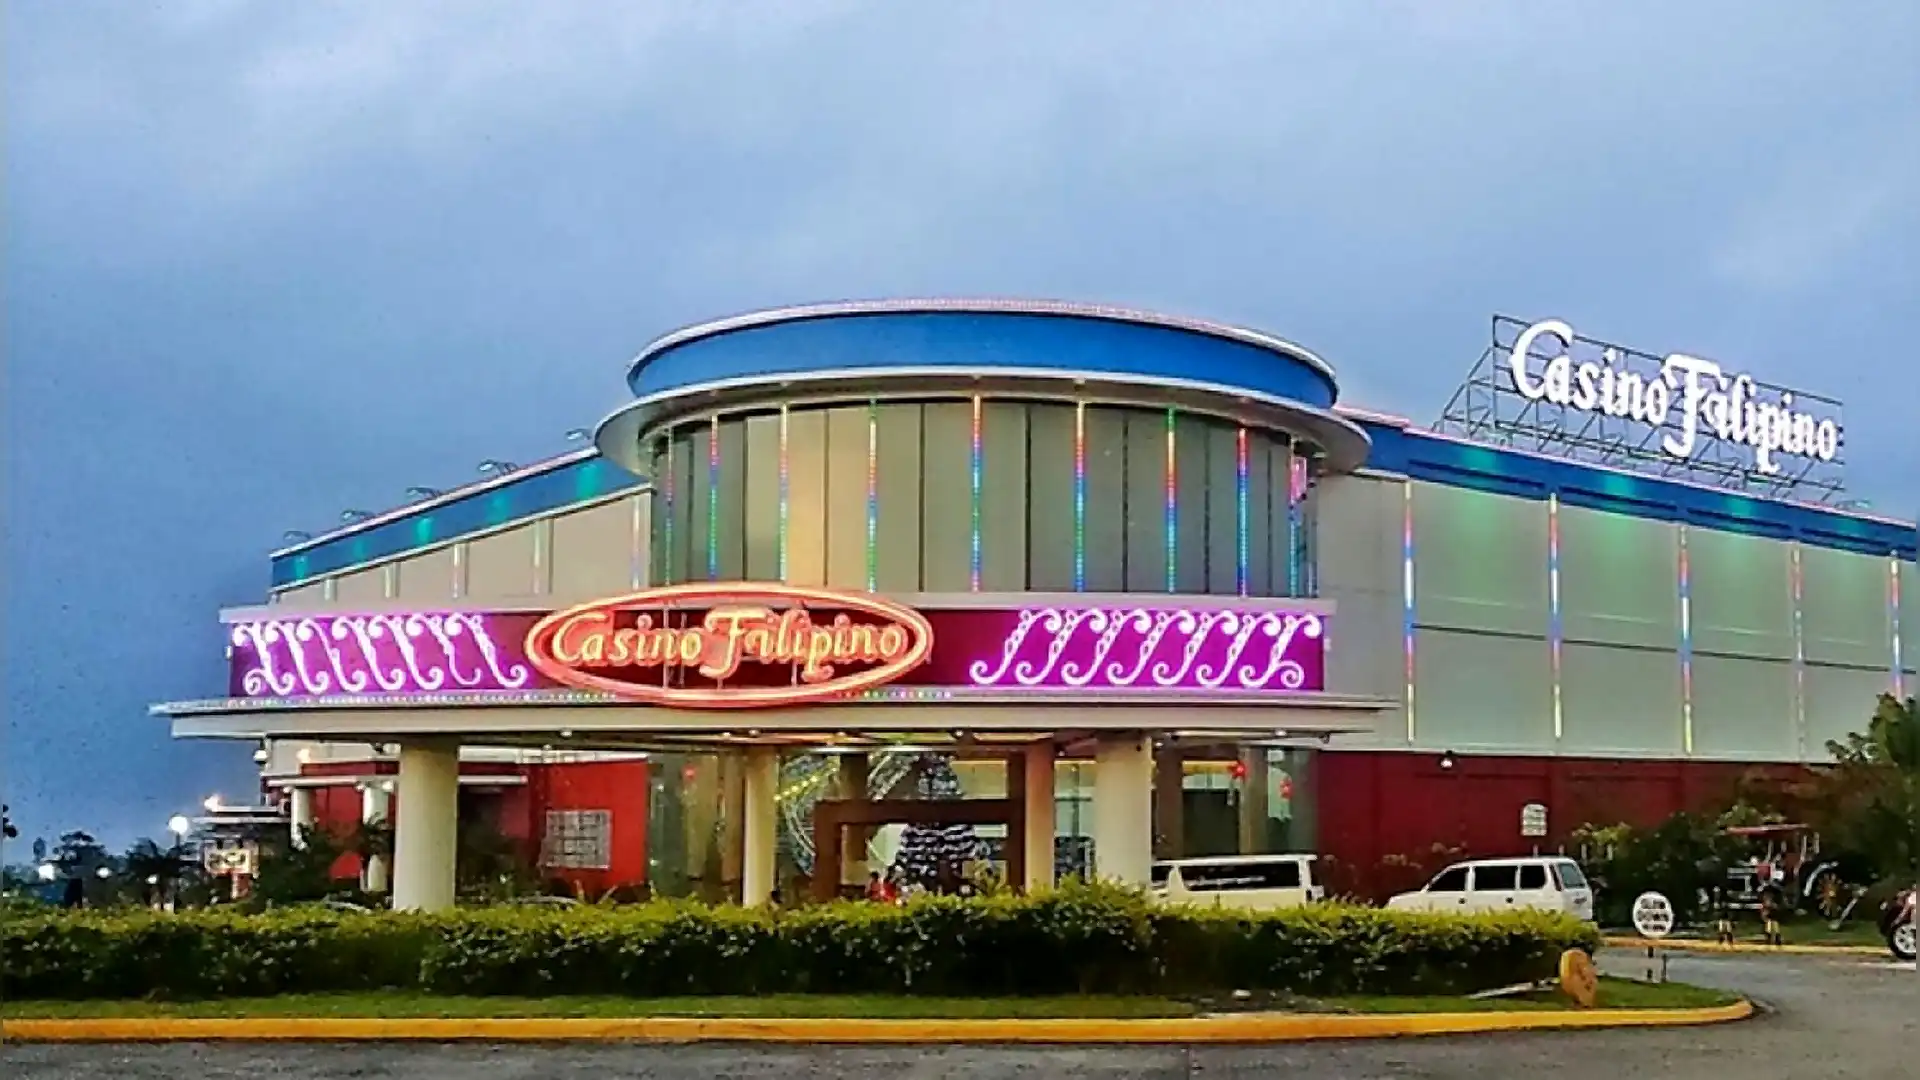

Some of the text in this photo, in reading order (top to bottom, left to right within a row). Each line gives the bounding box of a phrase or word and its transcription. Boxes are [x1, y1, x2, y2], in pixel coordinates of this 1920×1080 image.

[1509, 318, 1838, 474] Casino Filipino
[550, 604, 910, 681] Casino Filipino
